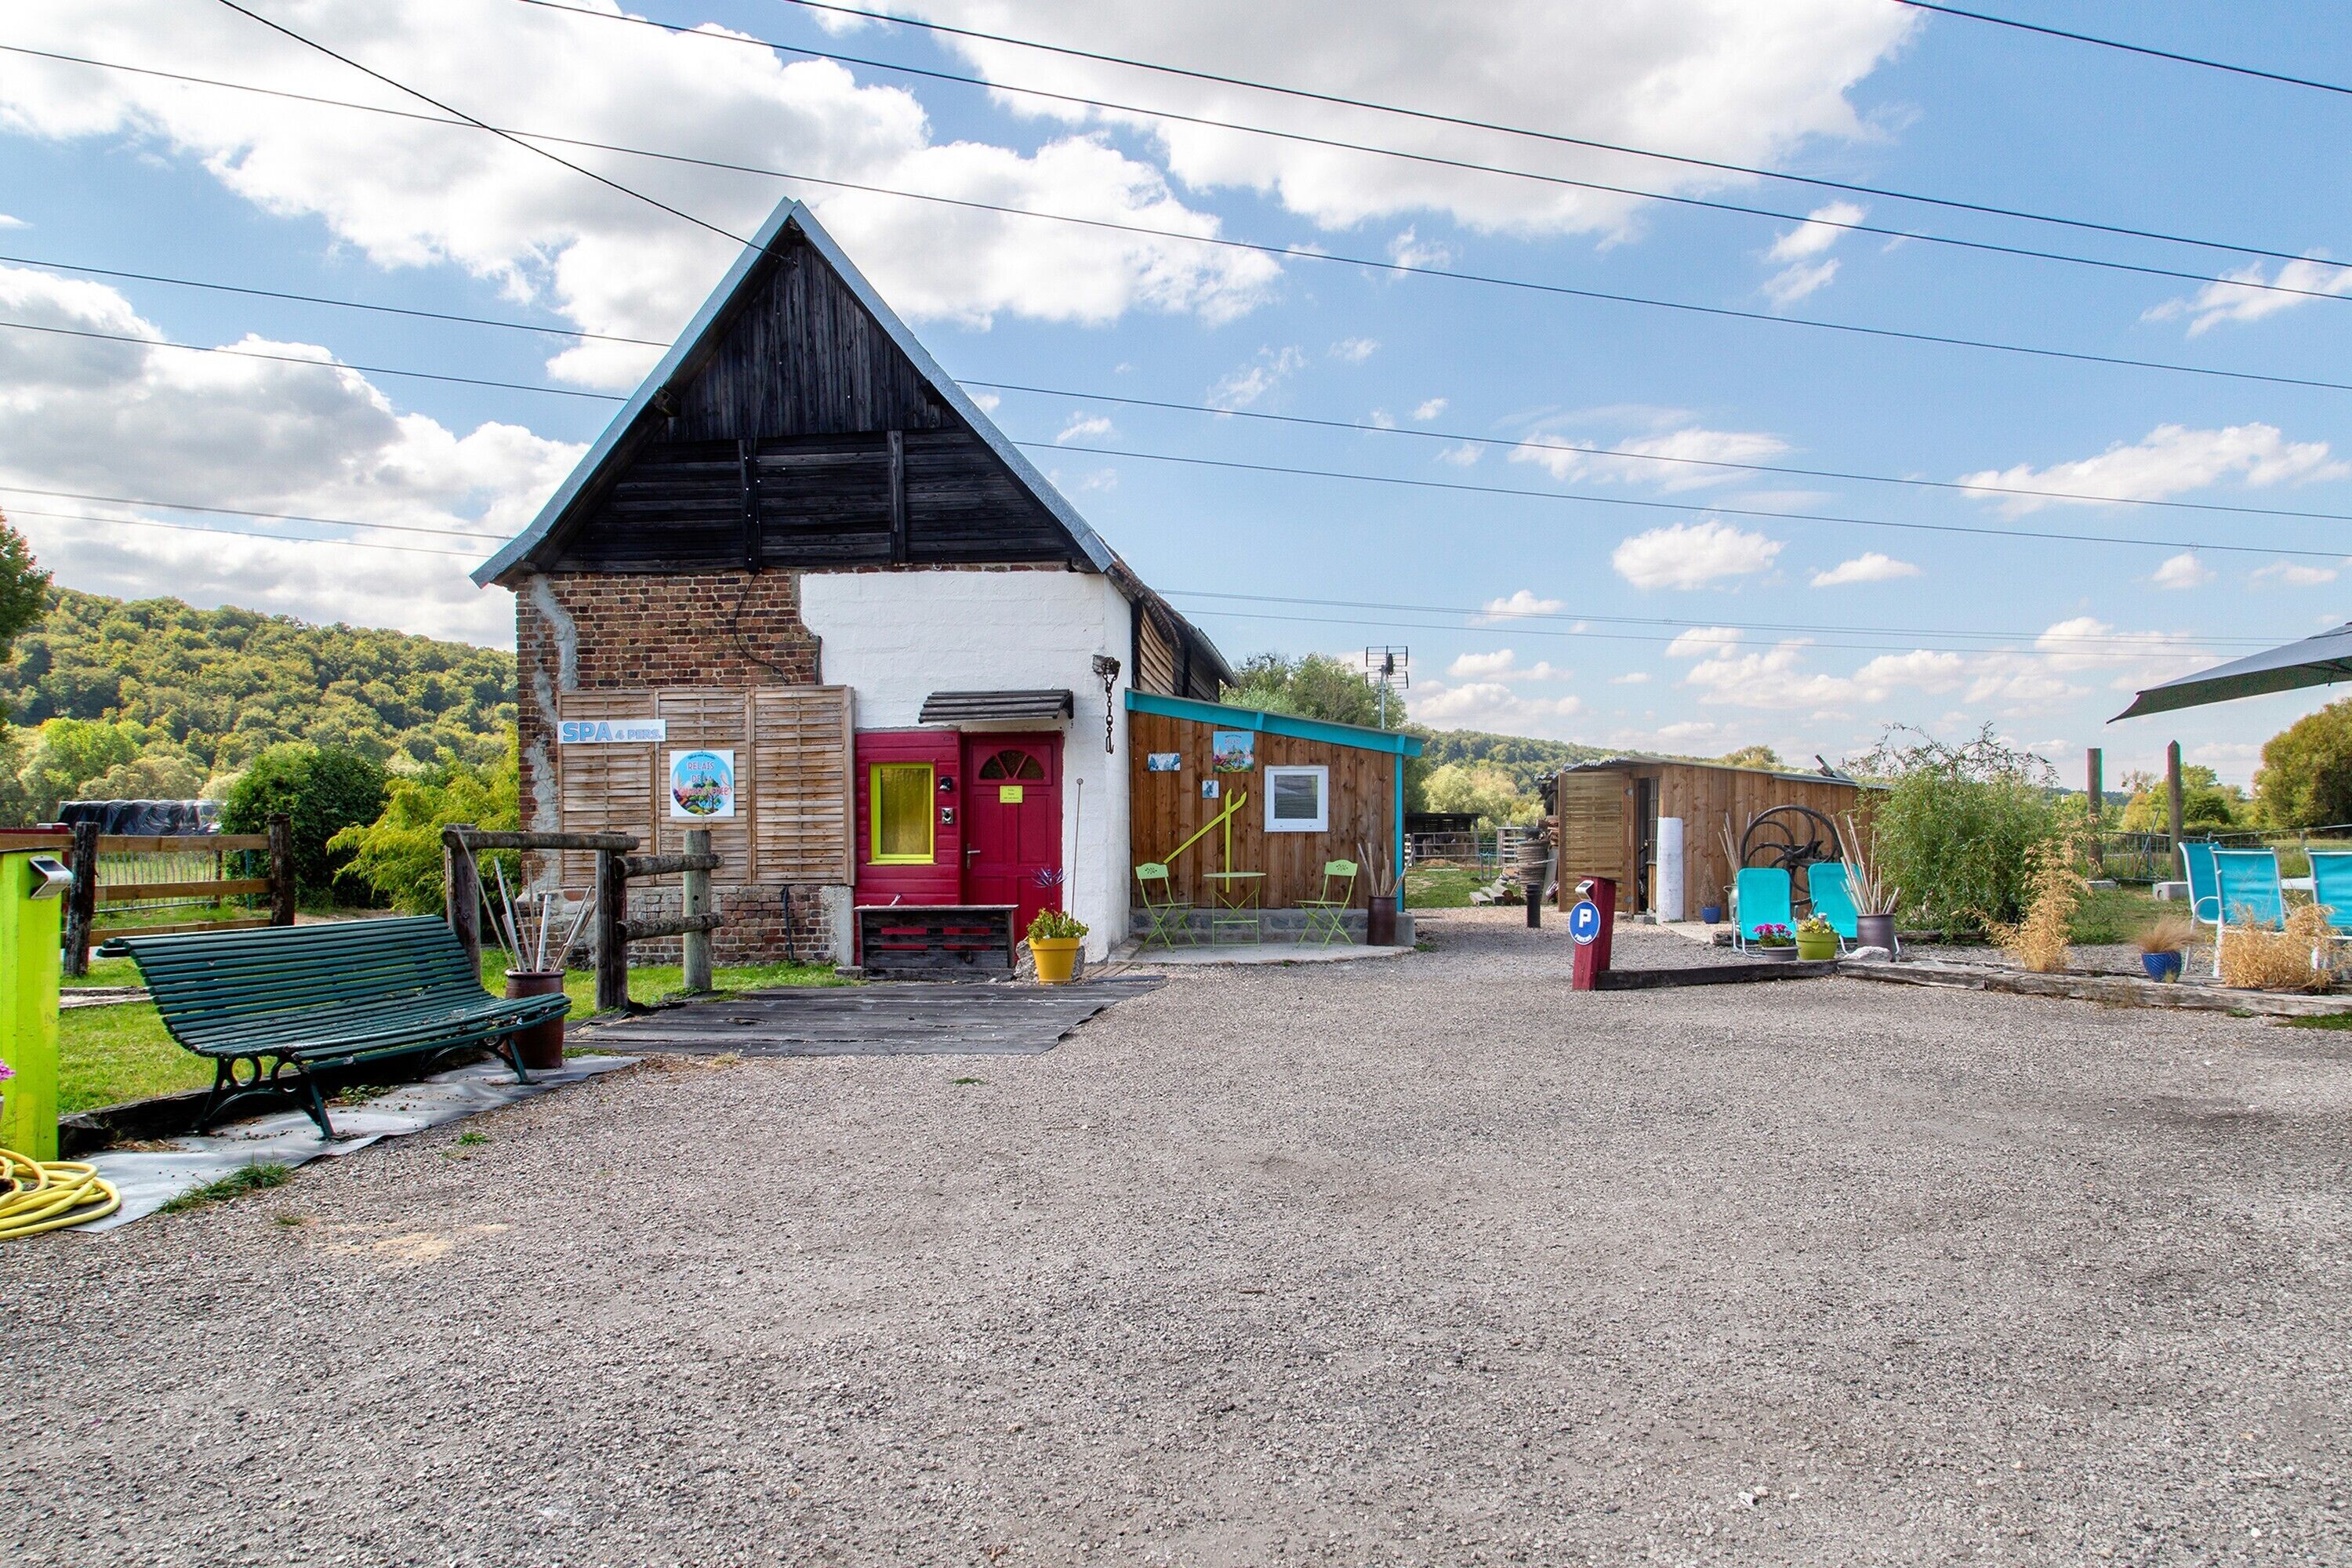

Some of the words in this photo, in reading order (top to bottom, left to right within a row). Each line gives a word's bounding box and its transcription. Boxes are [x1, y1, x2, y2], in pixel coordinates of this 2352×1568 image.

[563, 722, 613, 742] SPA
[615, 729, 625, 740] 4
[688, 761, 715, 770] RELAIS
[1578, 908, 1592, 928] P
